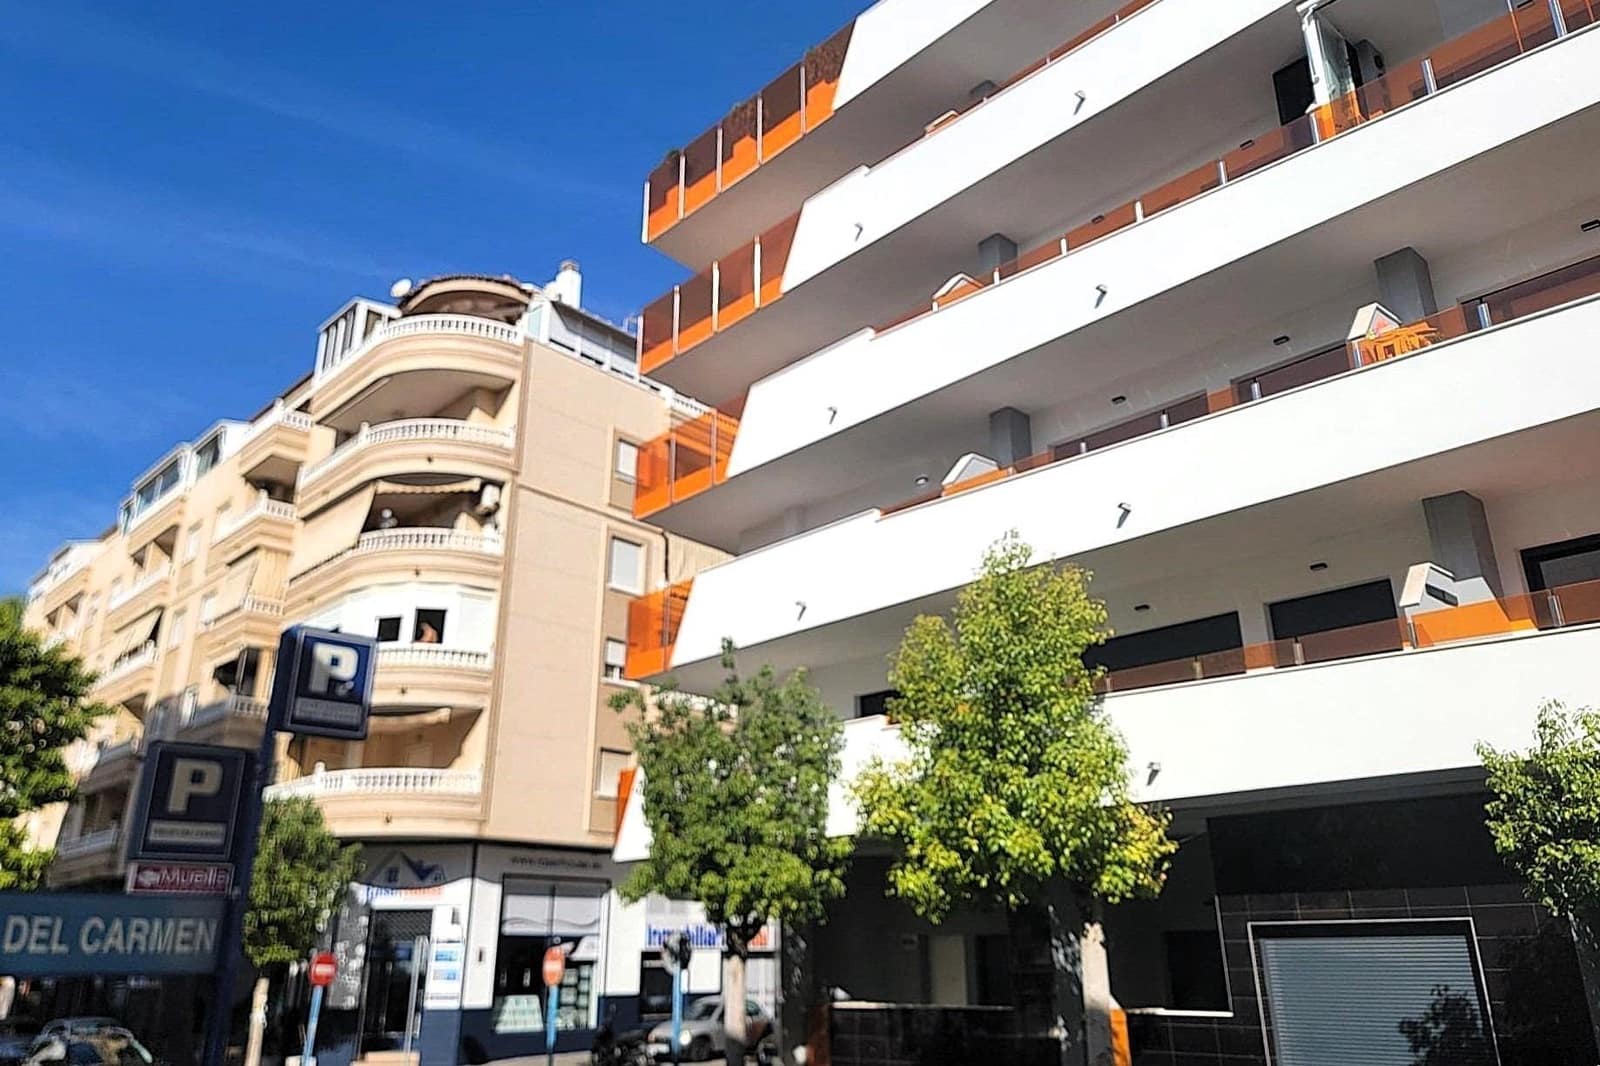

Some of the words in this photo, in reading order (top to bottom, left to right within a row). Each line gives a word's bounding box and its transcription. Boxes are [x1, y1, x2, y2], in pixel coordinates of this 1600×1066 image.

[309, 642, 360, 696] P
[167, 757, 223, 814] P
[3, 913, 69, 955] DEL
[79, 915, 218, 955] CARMEN
